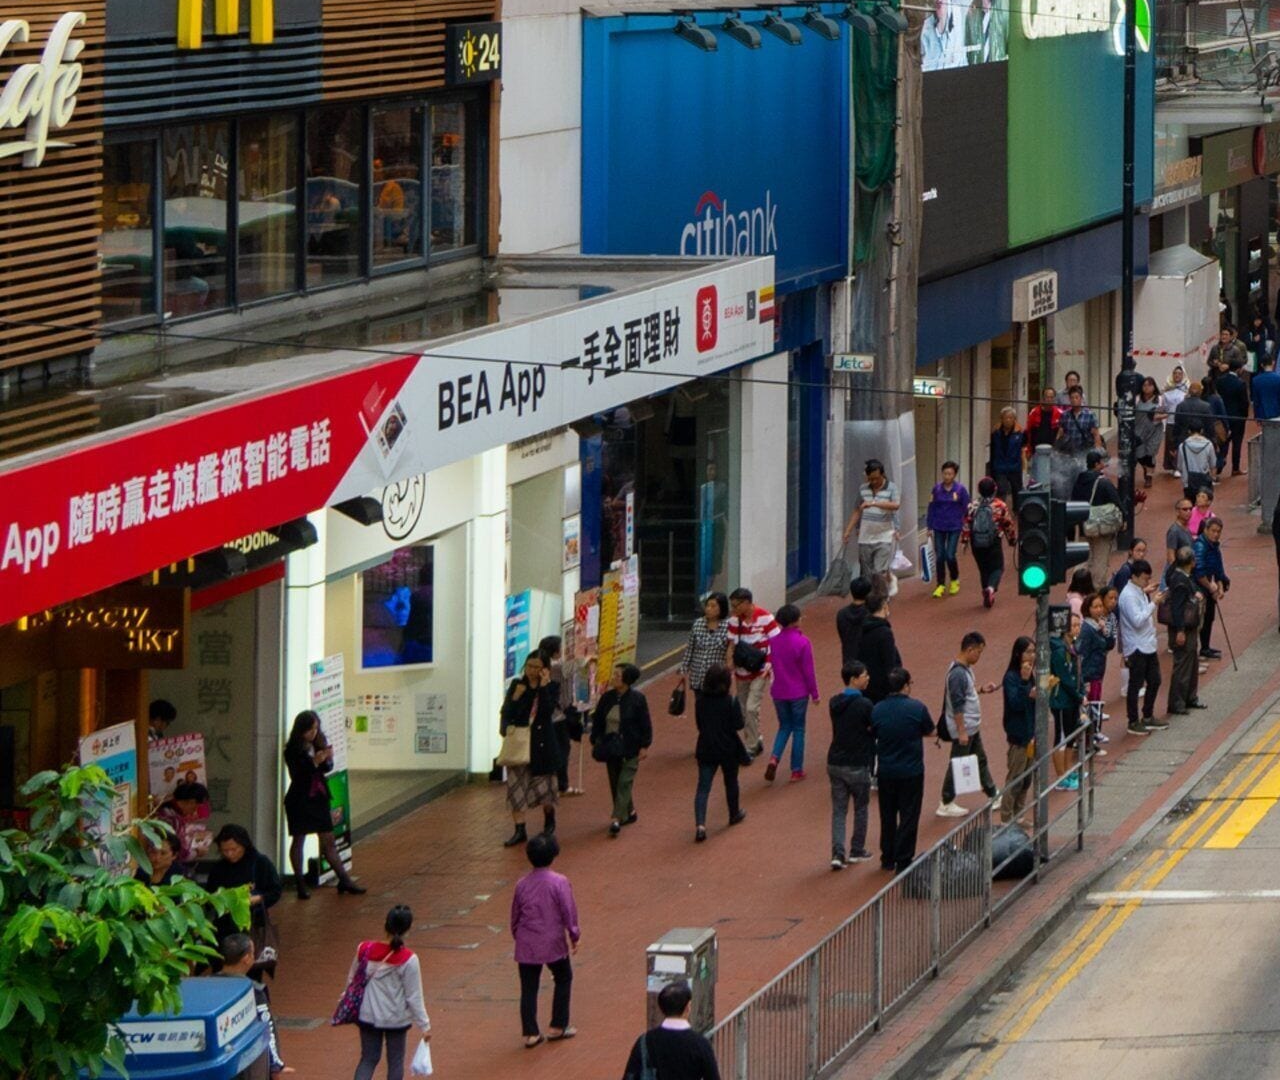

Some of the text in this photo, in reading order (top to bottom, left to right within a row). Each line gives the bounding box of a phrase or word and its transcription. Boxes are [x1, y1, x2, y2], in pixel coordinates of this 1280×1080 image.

[478, 33, 502, 72] 24
[438, 305, 681, 431] BEA App 一手全面理財
[1, 418, 332, 574] App 隨時贏走旗艦級智能電話
[117, 1032, 156, 1045] CCW
